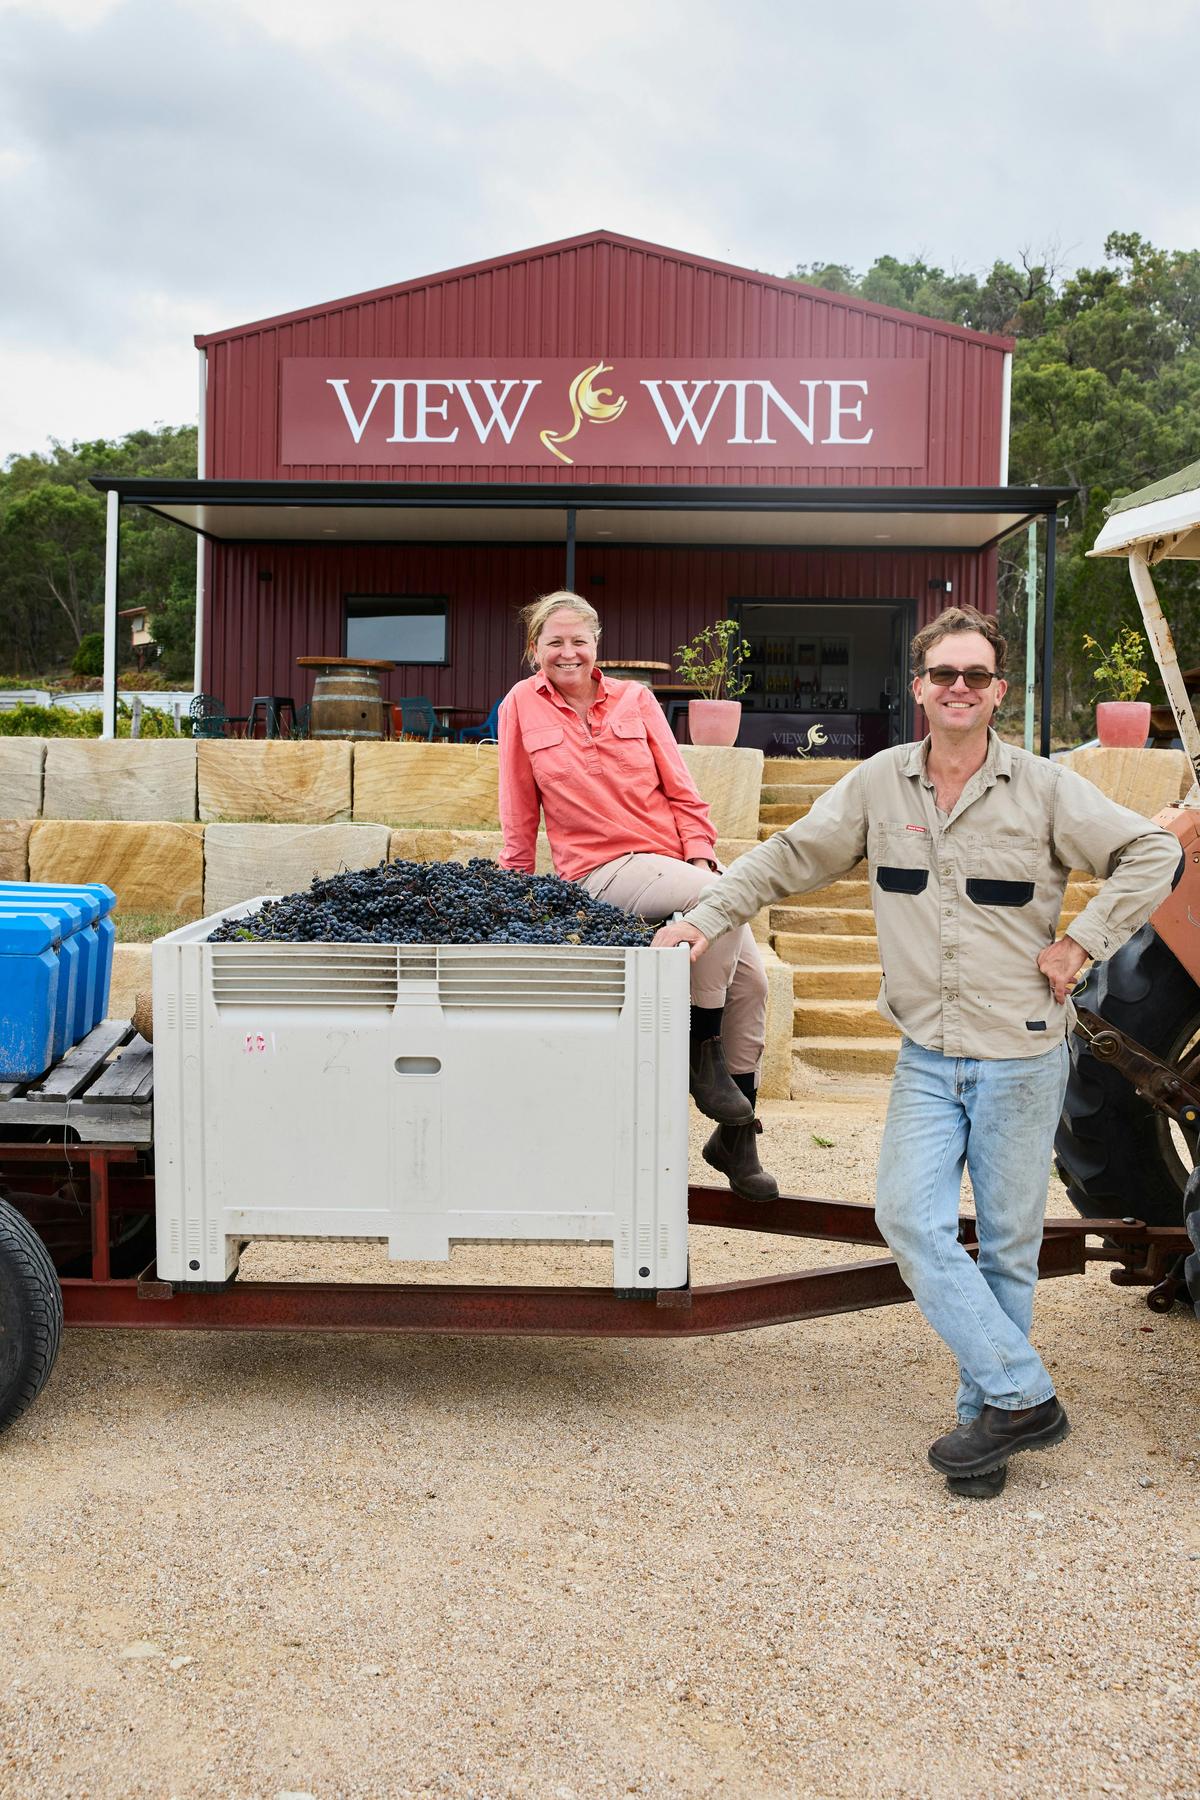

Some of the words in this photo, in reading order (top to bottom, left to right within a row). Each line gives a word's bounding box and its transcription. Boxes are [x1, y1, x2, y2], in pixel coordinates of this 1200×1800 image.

[326, 379, 542, 444] VIEW
[640, 380, 874, 445] WINE
[773, 732, 806, 745] VIEW
[828, 733, 865, 746] WINE
